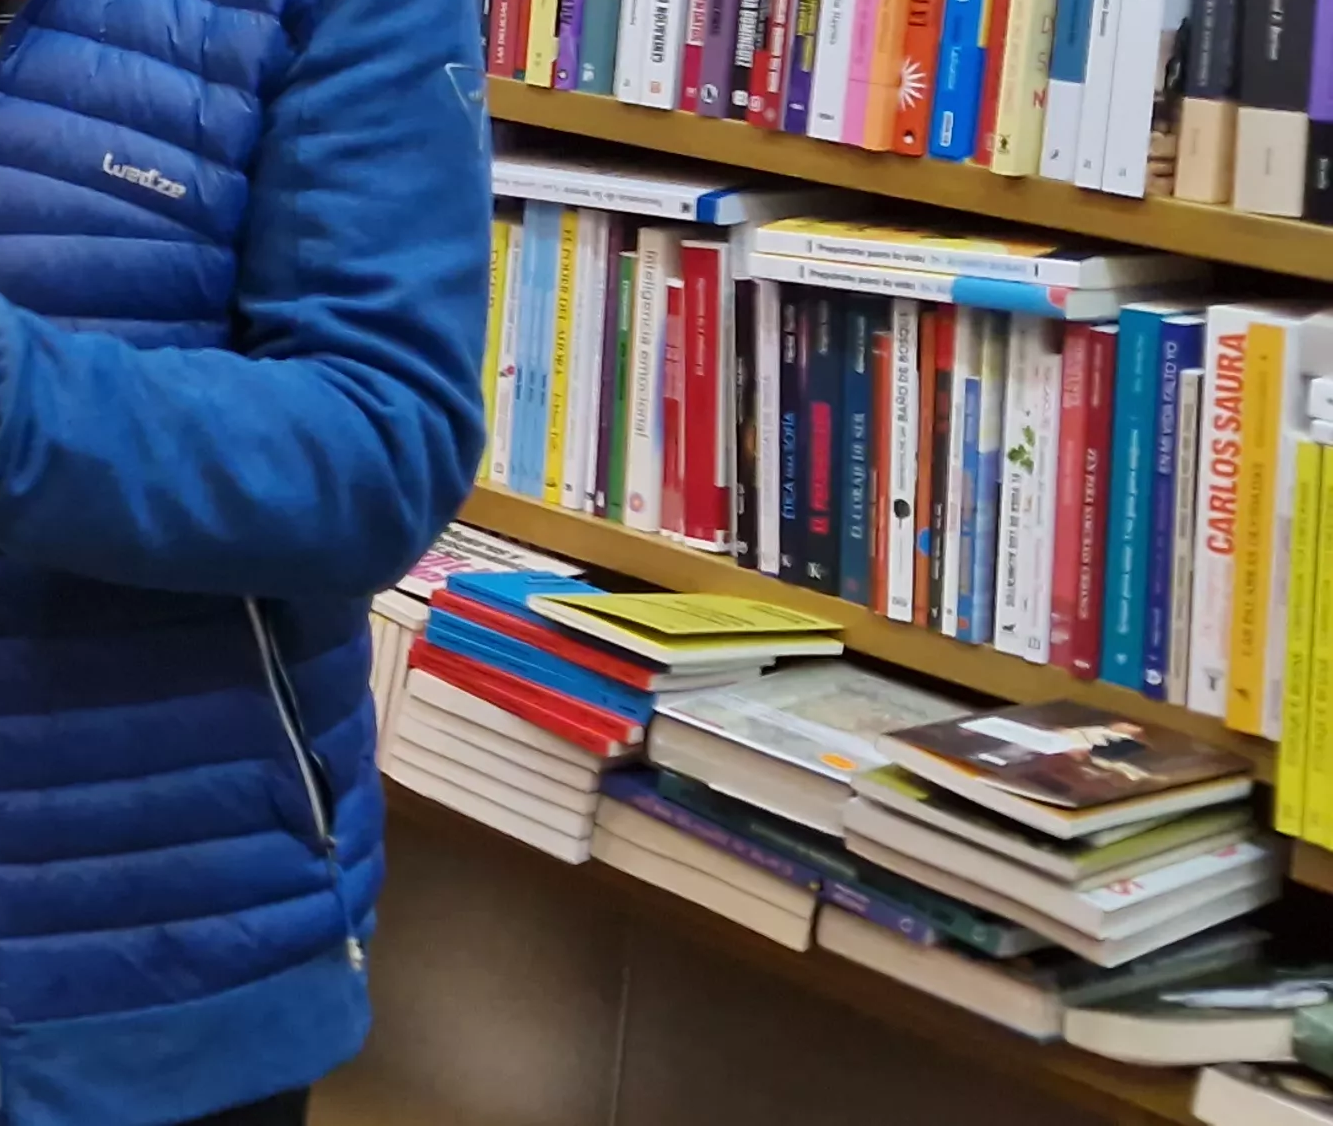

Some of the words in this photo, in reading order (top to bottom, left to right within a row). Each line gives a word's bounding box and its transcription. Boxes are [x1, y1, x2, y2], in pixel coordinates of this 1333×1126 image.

[652, 5, 668, 64] GENERACIÓN
[560, 248, 572, 293] PODER
[557, 296, 570, 325] DEL
[638, 249, 658, 345] Inteligencia
[554, 329, 568, 377] AHORA
[897, 310, 912, 364] BOSQUE
[1164, 342, 1177, 361] YO
[633, 350, 654, 438] emocional
[897, 366, 910, 384] DE
[1211, 332, 1245, 434] SAURA
[854, 413, 865, 438] SER
[896, 386, 909, 423] BAÑO
[852, 443, 866, 461] DE
[1159, 455, 1172, 475] EN
[1206, 438, 1240, 556] CARLOS
